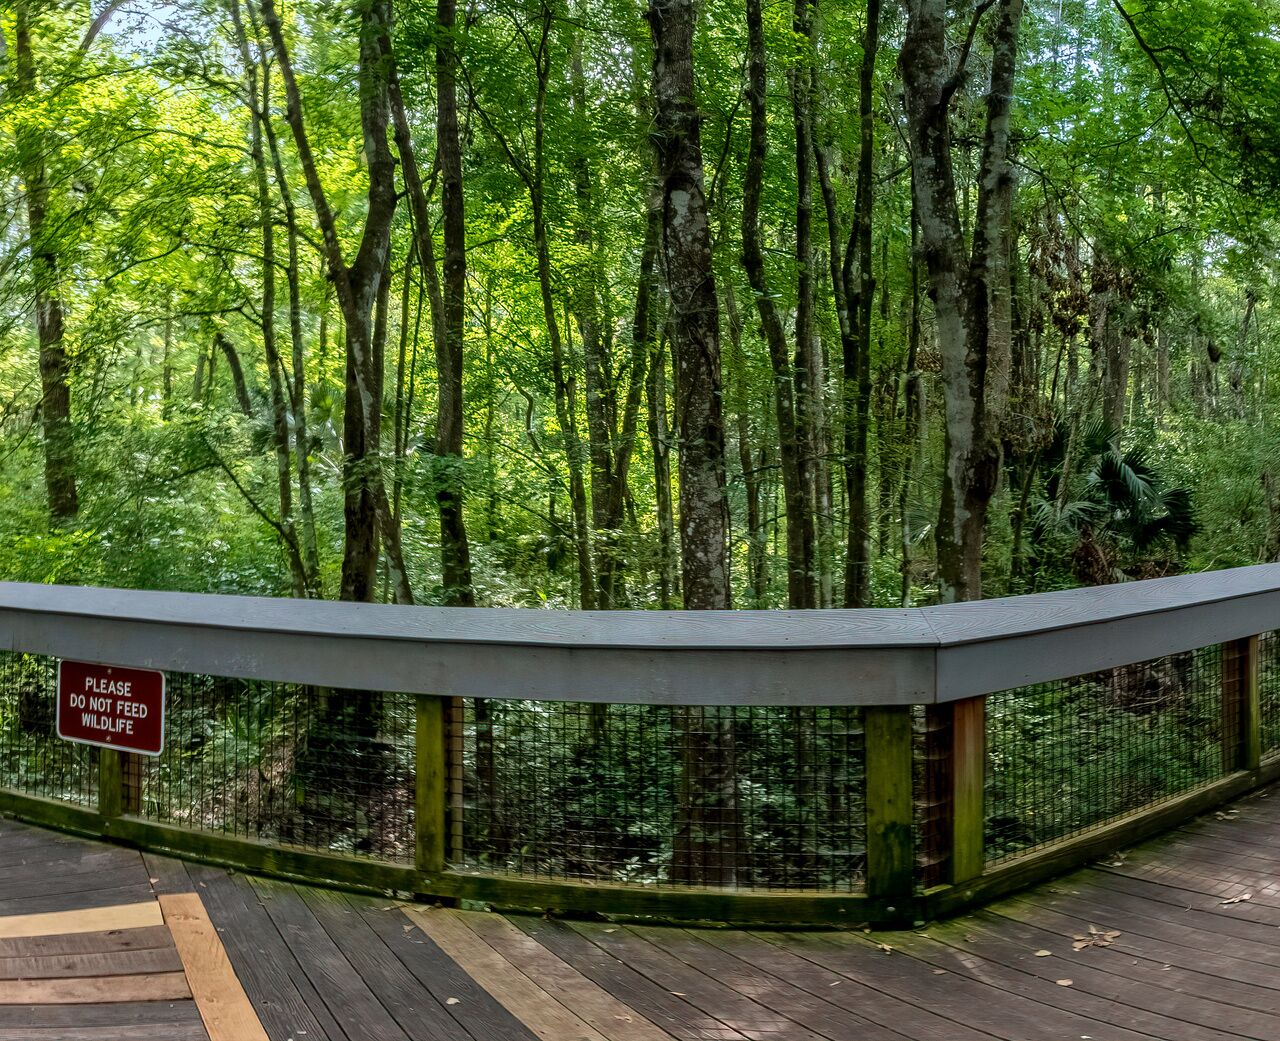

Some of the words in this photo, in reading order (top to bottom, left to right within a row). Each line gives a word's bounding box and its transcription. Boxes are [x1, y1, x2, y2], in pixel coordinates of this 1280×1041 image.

[85, 677, 131, 697] PLEASE
[70, 693, 85, 709] DO
[89, 696, 112, 713] NOT
[117, 700, 148, 718] FEED
[82, 712, 133, 735] WILDLIFE
